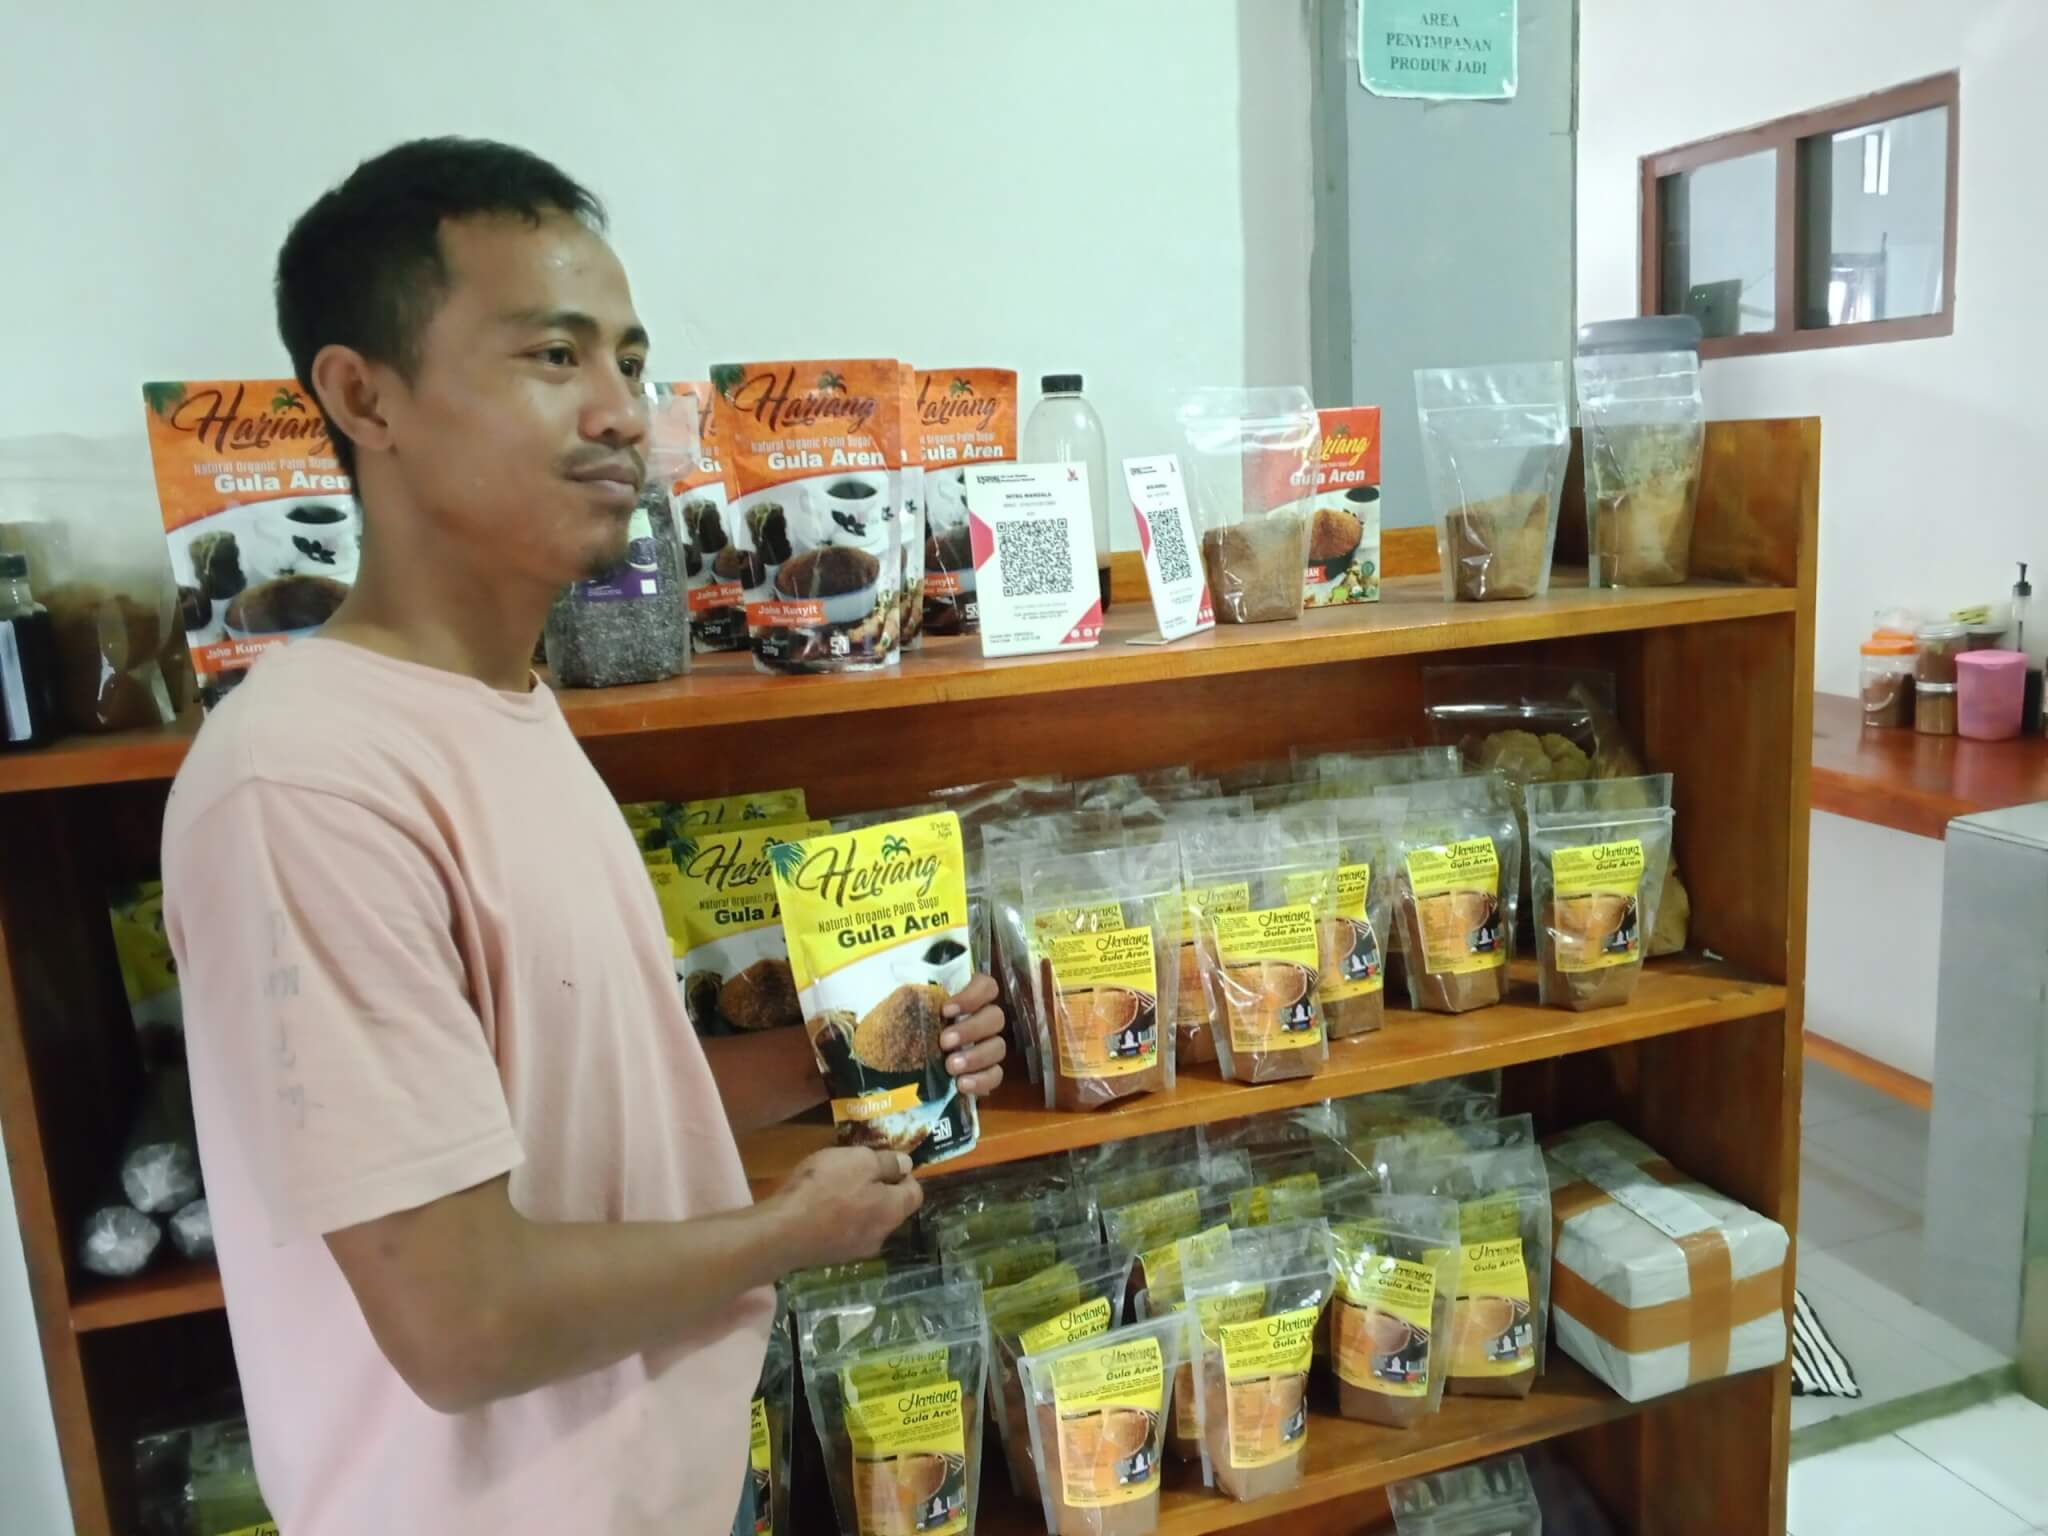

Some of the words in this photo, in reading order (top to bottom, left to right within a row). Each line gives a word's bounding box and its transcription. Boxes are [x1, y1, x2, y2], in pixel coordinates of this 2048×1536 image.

[1420, 13, 1460, 28] AREA
[1386, 32, 1492, 52] PENYIMPANAN
[1390, 56, 1450, 73] PRODUK
[1454, 59, 1487, 75] JADI
[734, 367, 876, 434] Hariang
[962, 441, 1003, 459] Aren
[767, 450, 823, 470] Gula
[831, 448, 884, 467] Aren
[215, 473, 280, 493] Gula
[1329, 468, 1365, 484] Aren
[783, 603, 818, 618] Kunyit
[795, 839, 941, 908] Hariang
[715, 907, 764, 924] Gula
[818, 914, 853, 933] Natural
[855, 907, 891, 925] Organic
[894, 900, 916, 916] Palm
[838, 923, 896, 948] Gula
[904, 911, 950, 934] Aren
[1264, 927, 1287, 937] Gula
[1289, 926, 1312, 934] Aren
[1100, 953, 1123, 962] Gula
[1125, 950, 1148, 959] Aren
[1067, 1329, 1088, 1342] Gula
[1273, 1338, 1296, 1349] Gula
[1106, 1369, 1131, 1381] Gula
[1134, 1364, 1158, 1375] Aren
[898, 1389, 957, 1412] Hariang
[903, 1414, 929, 1425] Gula
[932, 1408, 957, 1418] Aren
